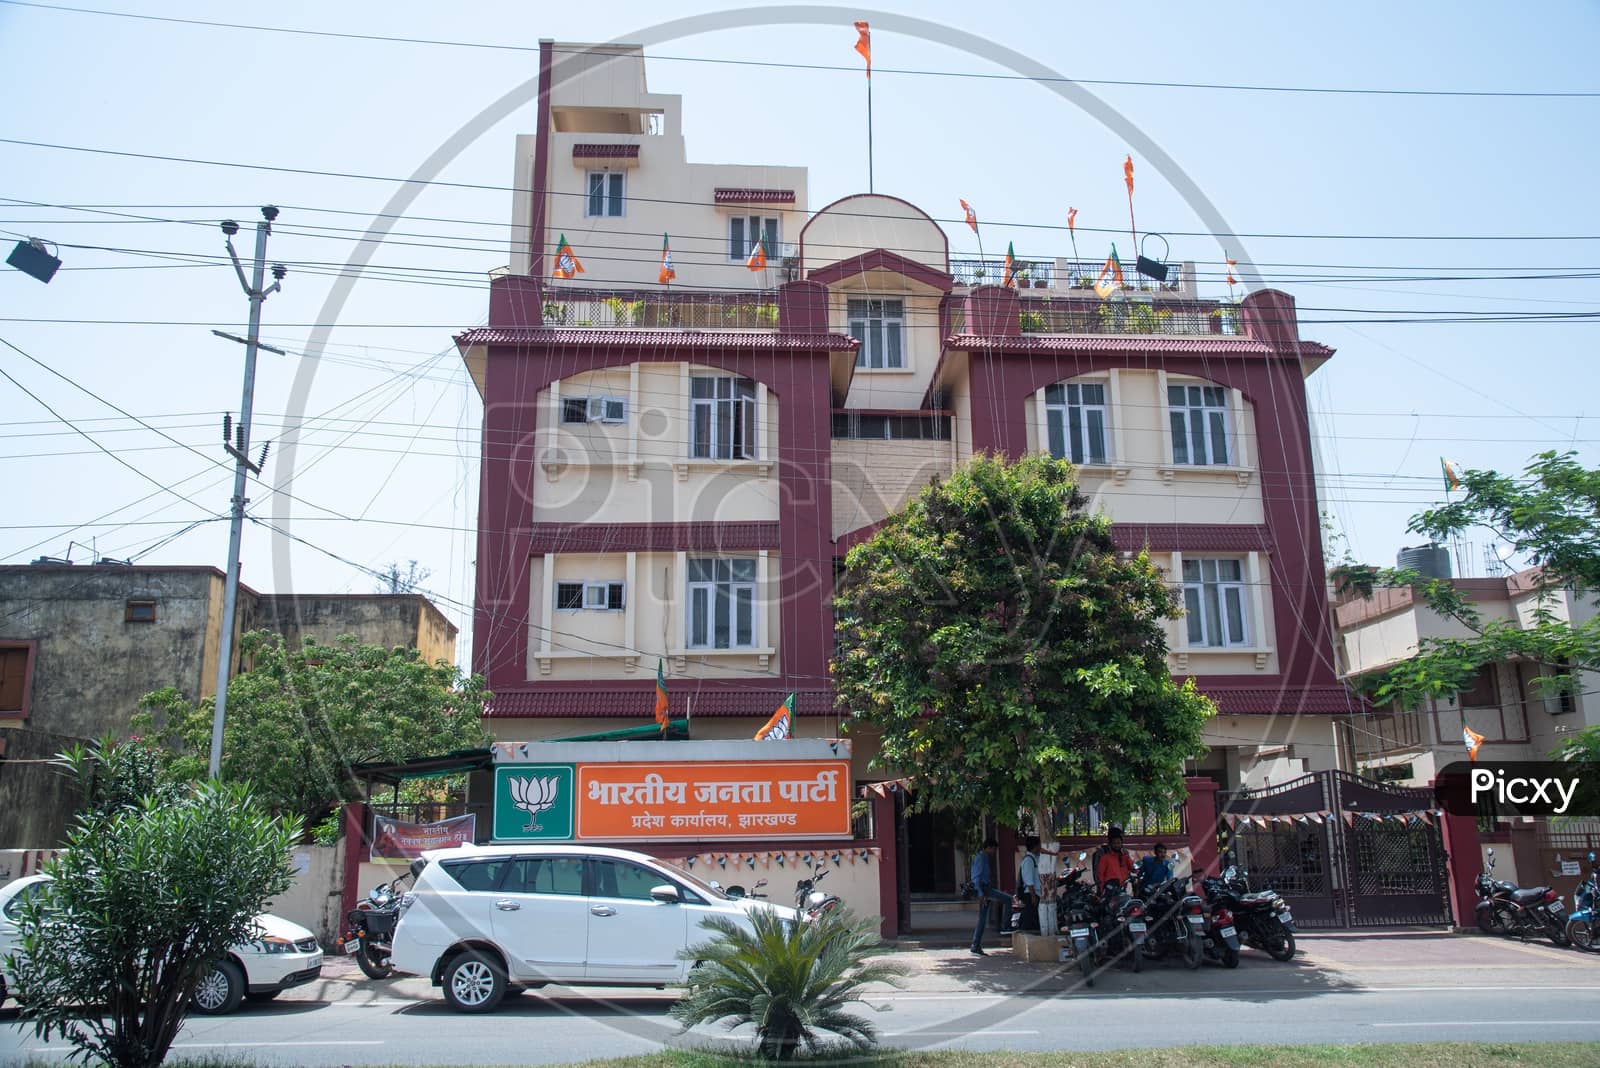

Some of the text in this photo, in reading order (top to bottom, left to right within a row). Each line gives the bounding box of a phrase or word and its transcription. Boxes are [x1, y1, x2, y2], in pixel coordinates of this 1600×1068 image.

[588, 770, 839, 805] भारतीय जनता पार्टी
[631, 810, 665, 829] प्रदेश
[738, 812, 798, 828] झारखण्ड
